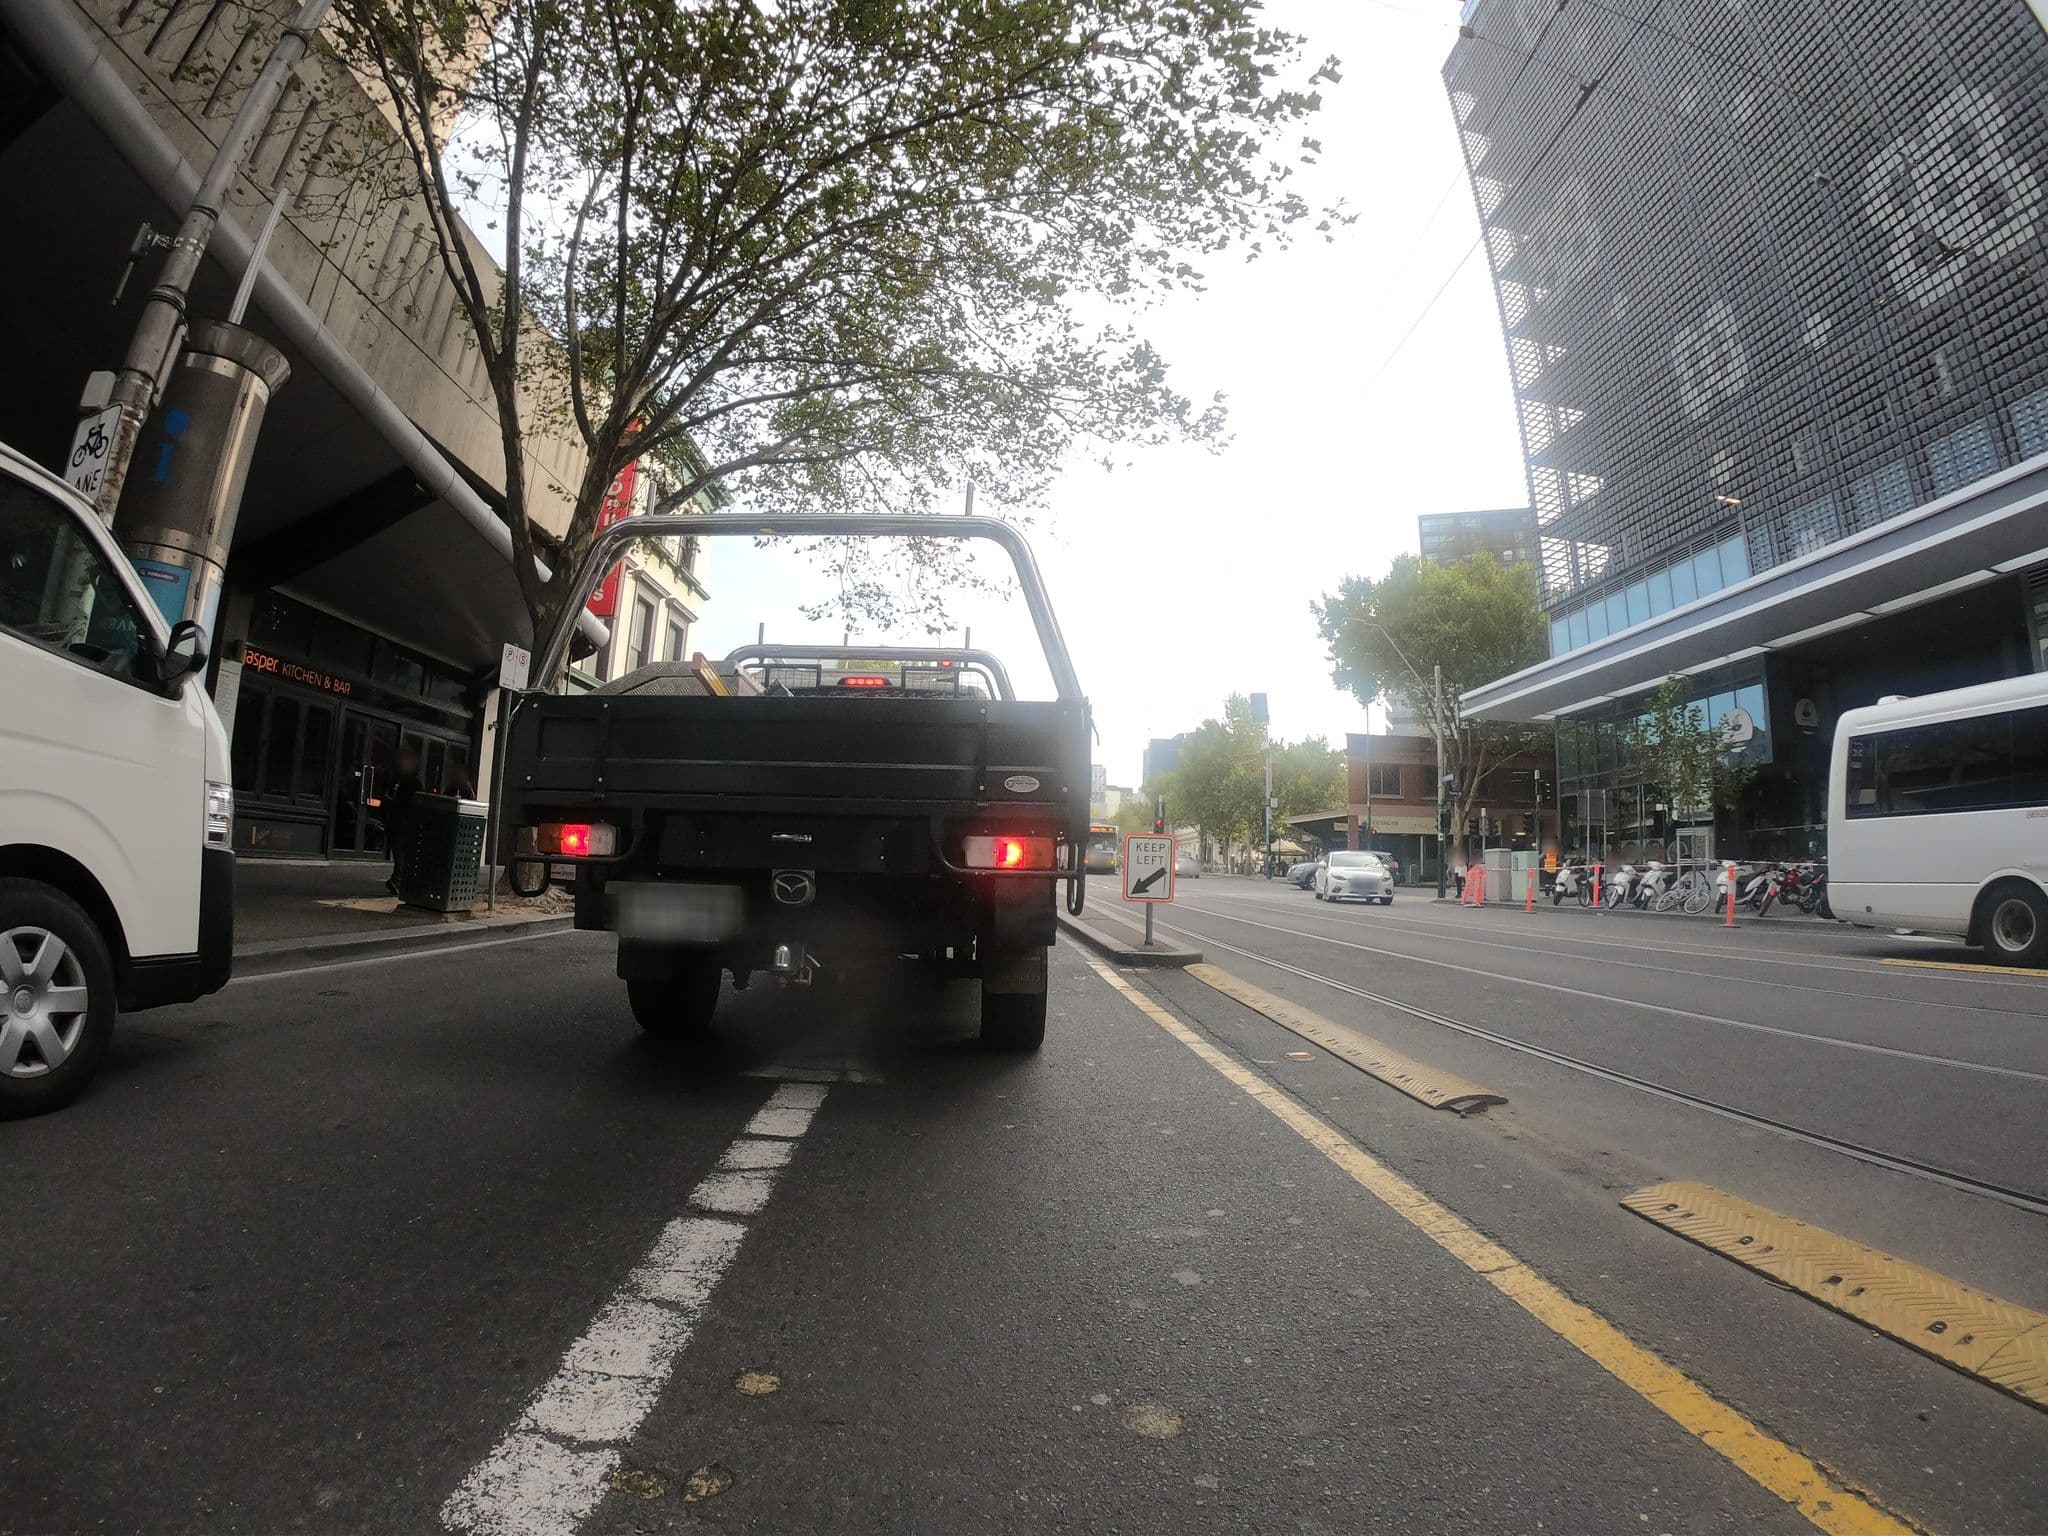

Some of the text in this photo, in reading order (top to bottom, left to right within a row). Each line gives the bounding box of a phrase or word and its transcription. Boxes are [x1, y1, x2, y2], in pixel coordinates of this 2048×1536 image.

[69, 468, 102, 493] ANE
[282, 663, 322, 686] KITCHEN
[324, 676, 331, 689] &
[333, 679, 351, 695] BAR
[1136, 843, 1166, 853] KEEP
[1136, 855, 1164, 865] LEFT
